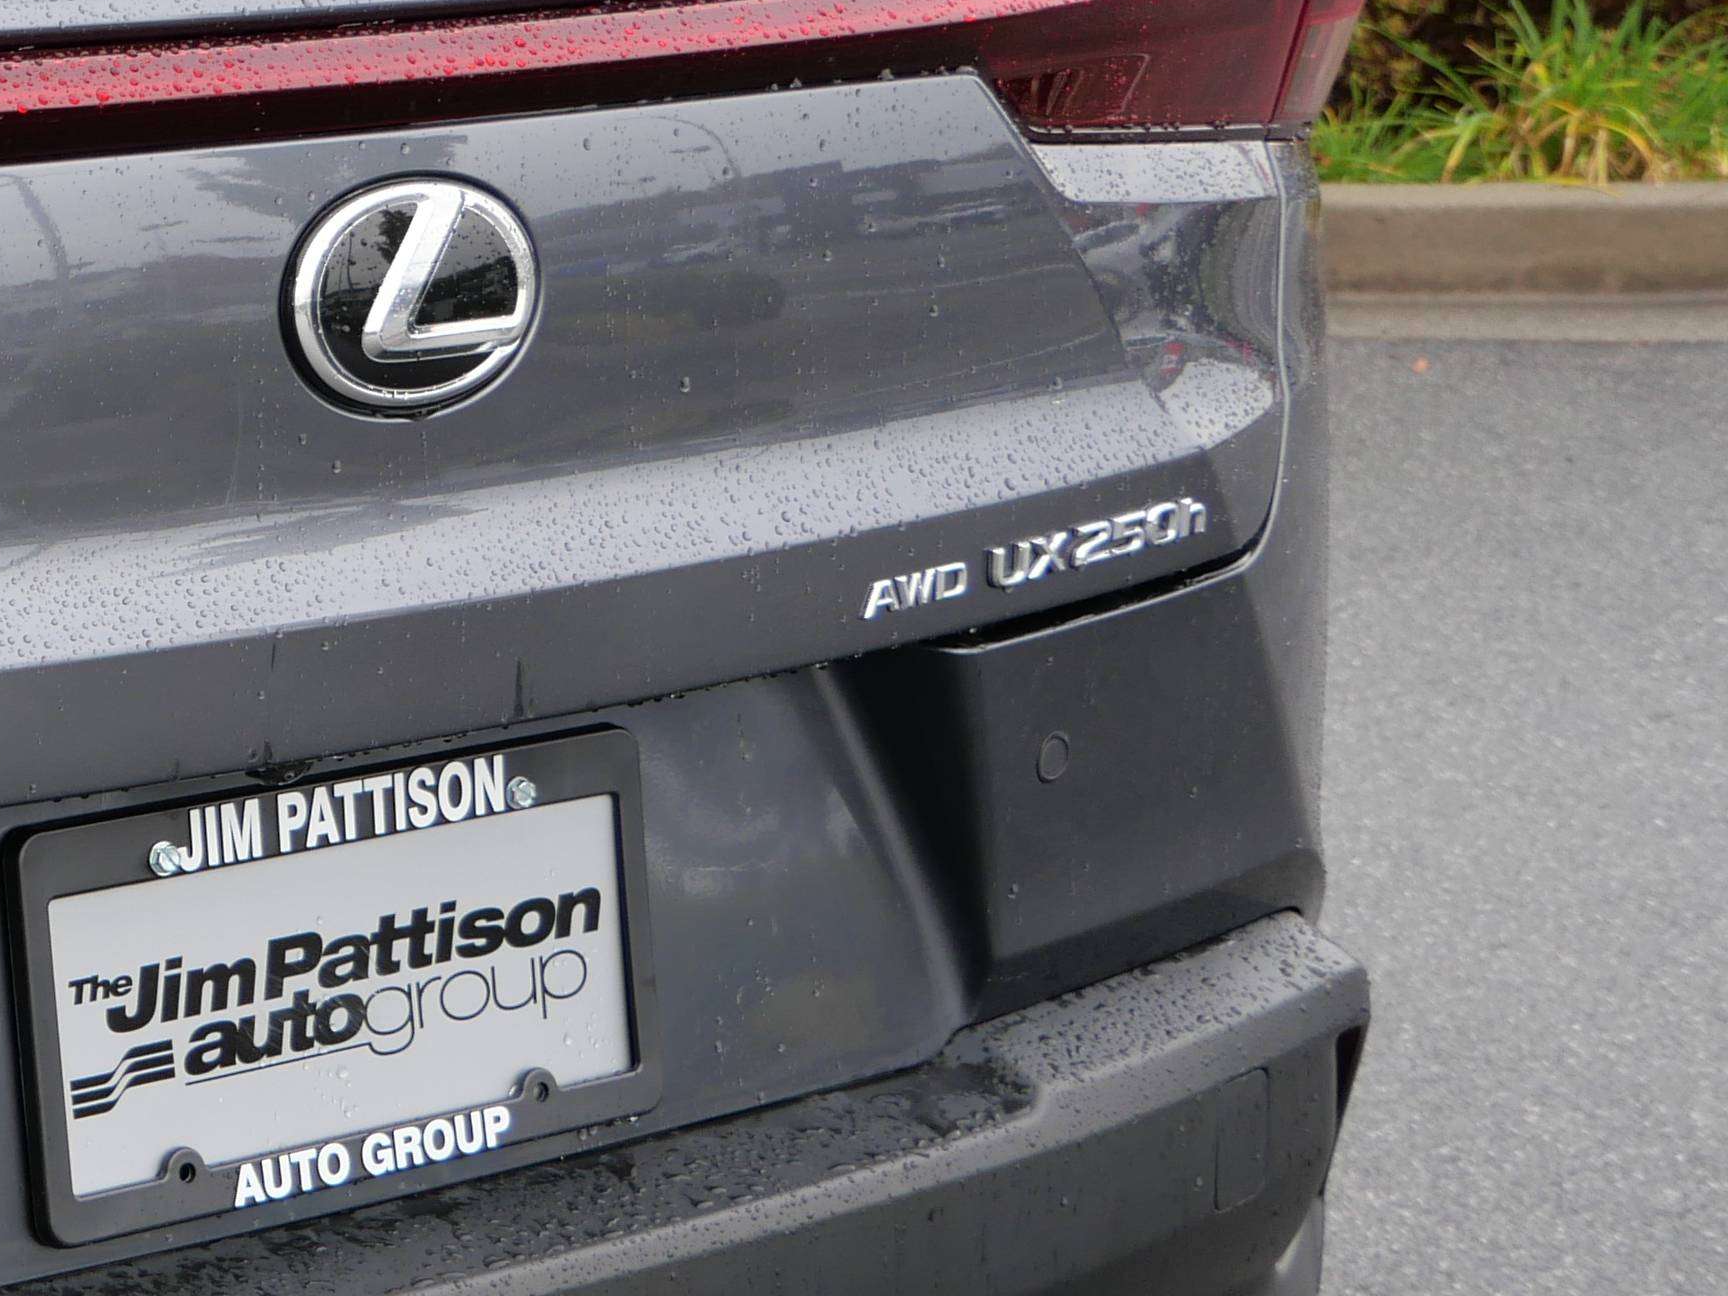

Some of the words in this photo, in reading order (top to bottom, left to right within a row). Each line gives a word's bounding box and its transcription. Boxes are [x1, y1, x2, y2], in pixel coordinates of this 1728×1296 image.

[860, 561, 967, 620] AWD
[177, 798, 262, 872] JIM
[277, 754, 507, 853] PATTISON
[67, 969, 134, 1007] The
[234, 1143, 348, 1208] AUTO
[360, 1105, 511, 1178] GROUP
